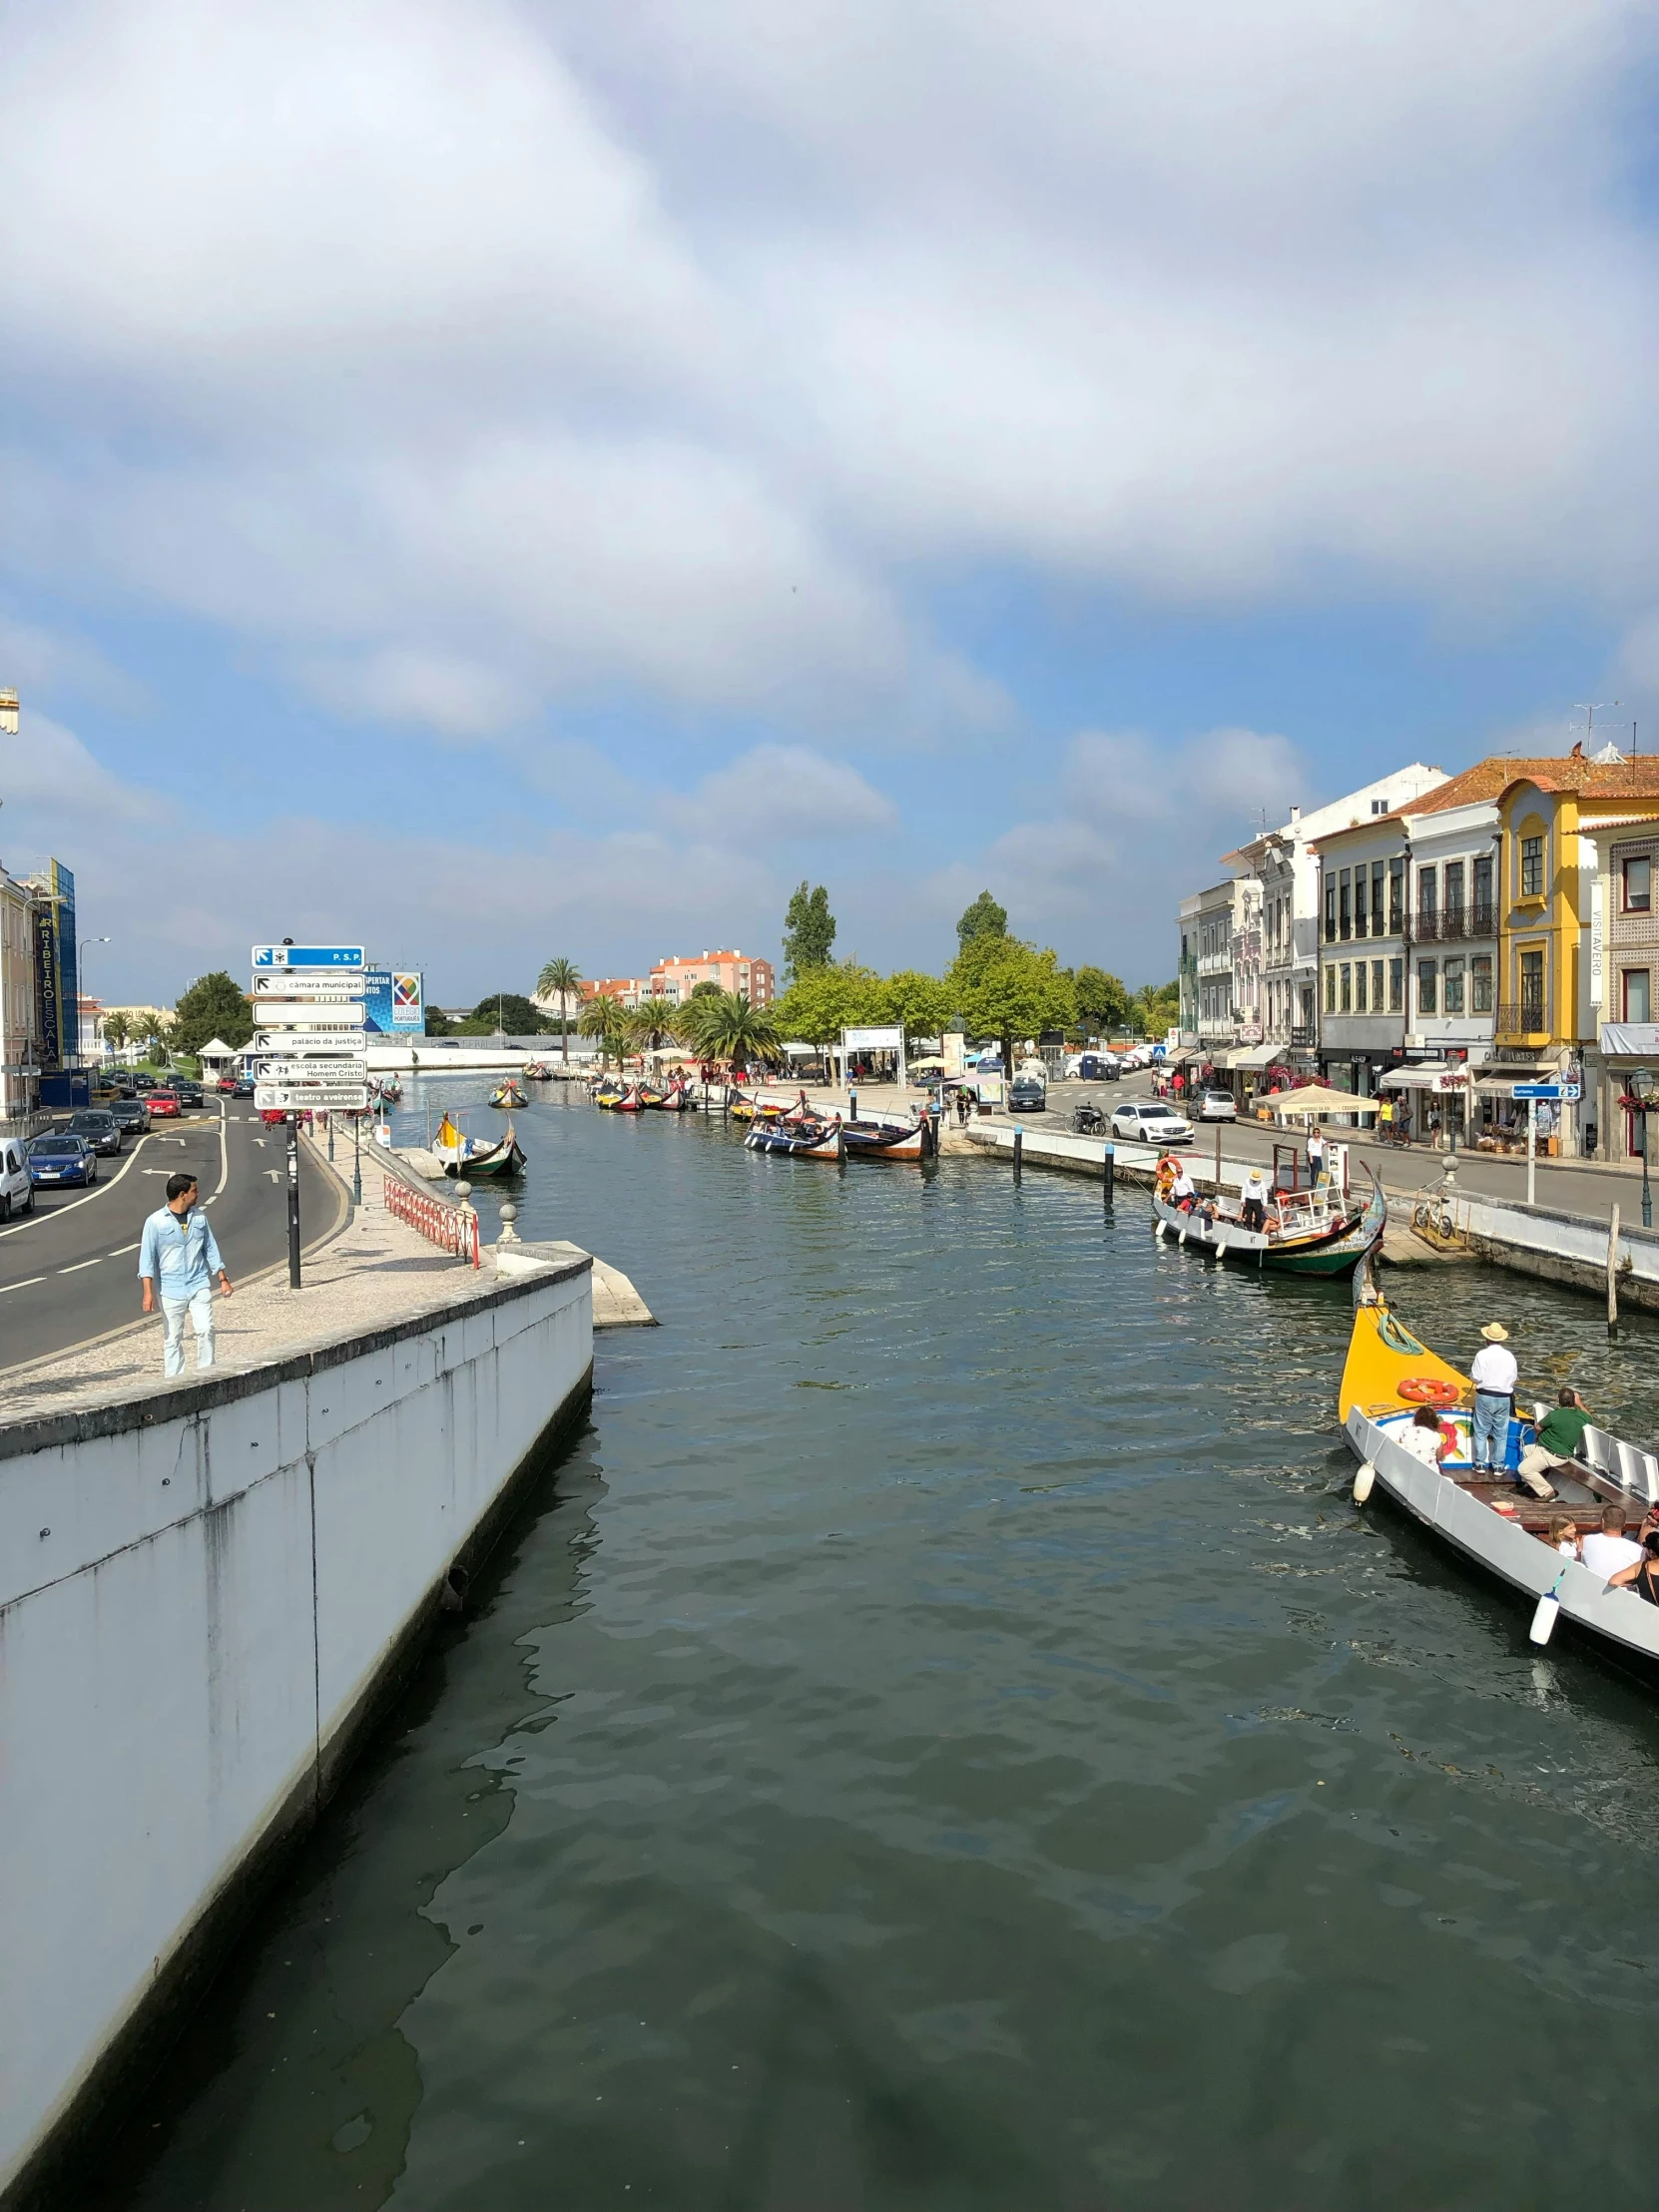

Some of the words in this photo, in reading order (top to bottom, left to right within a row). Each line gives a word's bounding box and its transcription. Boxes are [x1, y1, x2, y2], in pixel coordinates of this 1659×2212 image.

[321, 980, 361, 989] municipal
[394, 1005, 420, 1016] COLÉGIO
[334, 1037, 362, 1046] justiça
